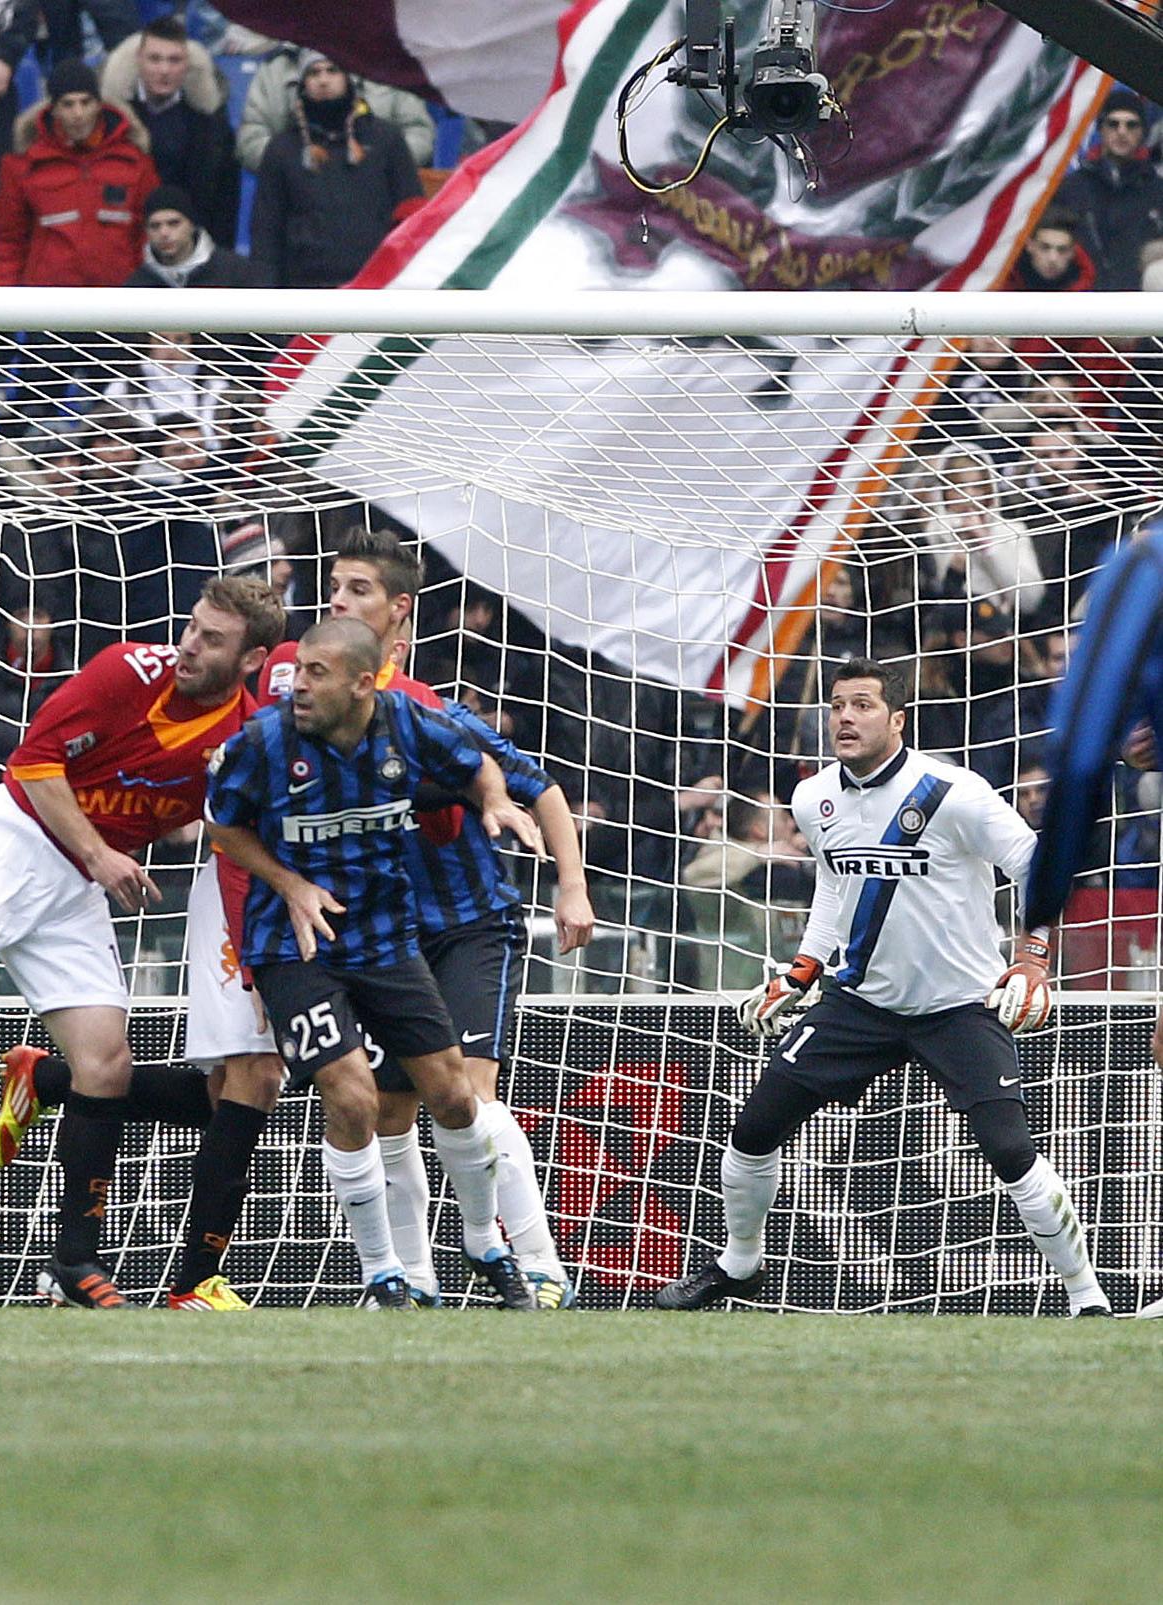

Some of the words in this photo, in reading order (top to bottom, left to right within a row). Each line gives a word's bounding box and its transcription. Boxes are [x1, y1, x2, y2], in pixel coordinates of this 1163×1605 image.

[822, 846, 931, 877] PIRELLI
[290, 1000, 342, 1061] 25
[781, 1026, 816, 1064] 1
